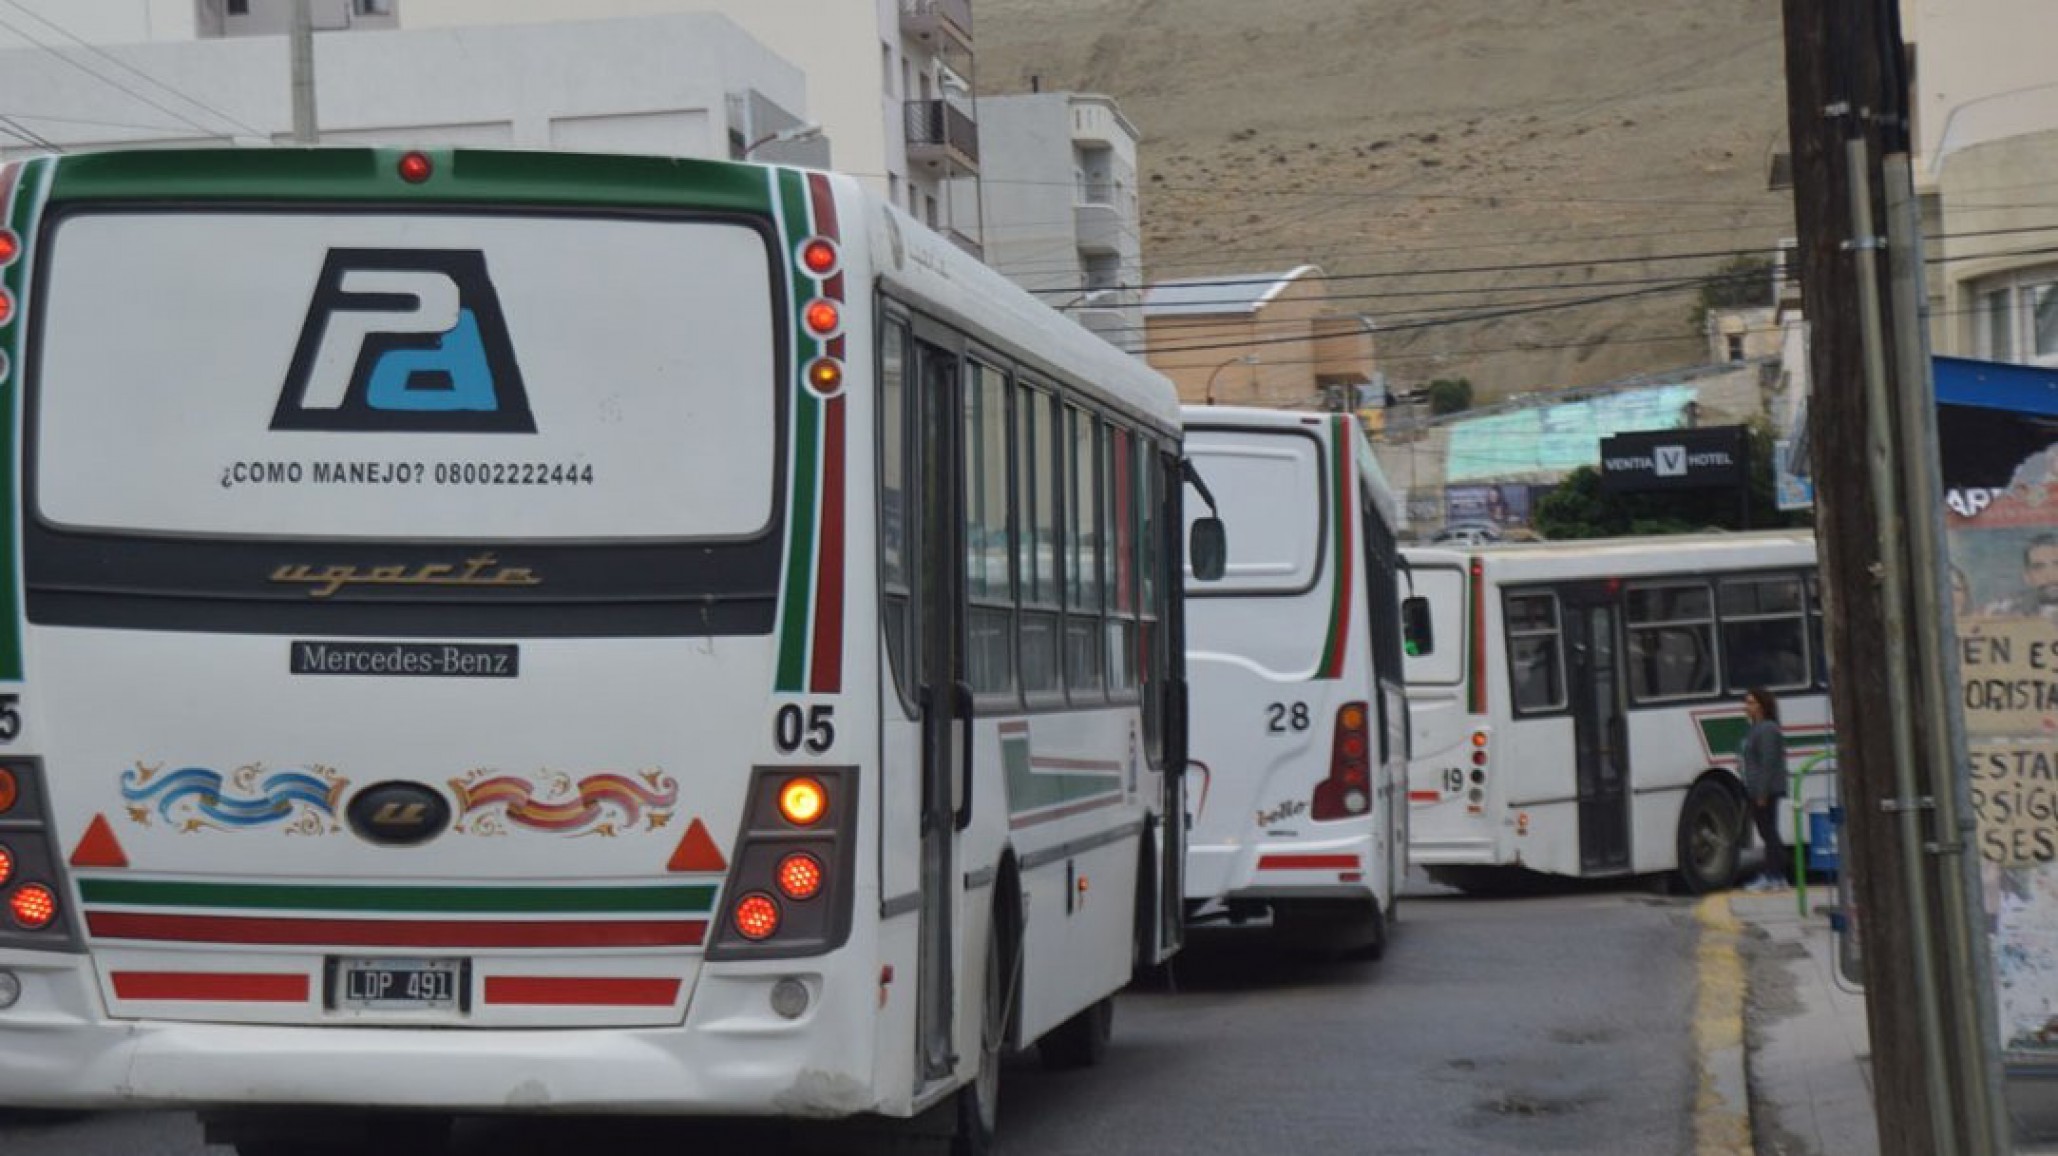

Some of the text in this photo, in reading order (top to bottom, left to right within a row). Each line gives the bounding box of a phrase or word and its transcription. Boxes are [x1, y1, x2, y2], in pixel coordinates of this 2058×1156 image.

[220, 462, 594, 488] ¿COMO MANEJO? 08002222444
[1660, 450, 1682, 472] V
[1688, 452, 1733, 467] HOTEL
[1956, 625, 2012, 665] ÉN
[303, 646, 508, 675] Mercedes-Benz
[775, 703, 835, 755] 05
[1266, 700, 1311, 734] 28
[1442, 768, 1464, 792] 19
[1968, 751, 2058, 780] ESTA
[350, 972, 450, 1000] LDP 491
